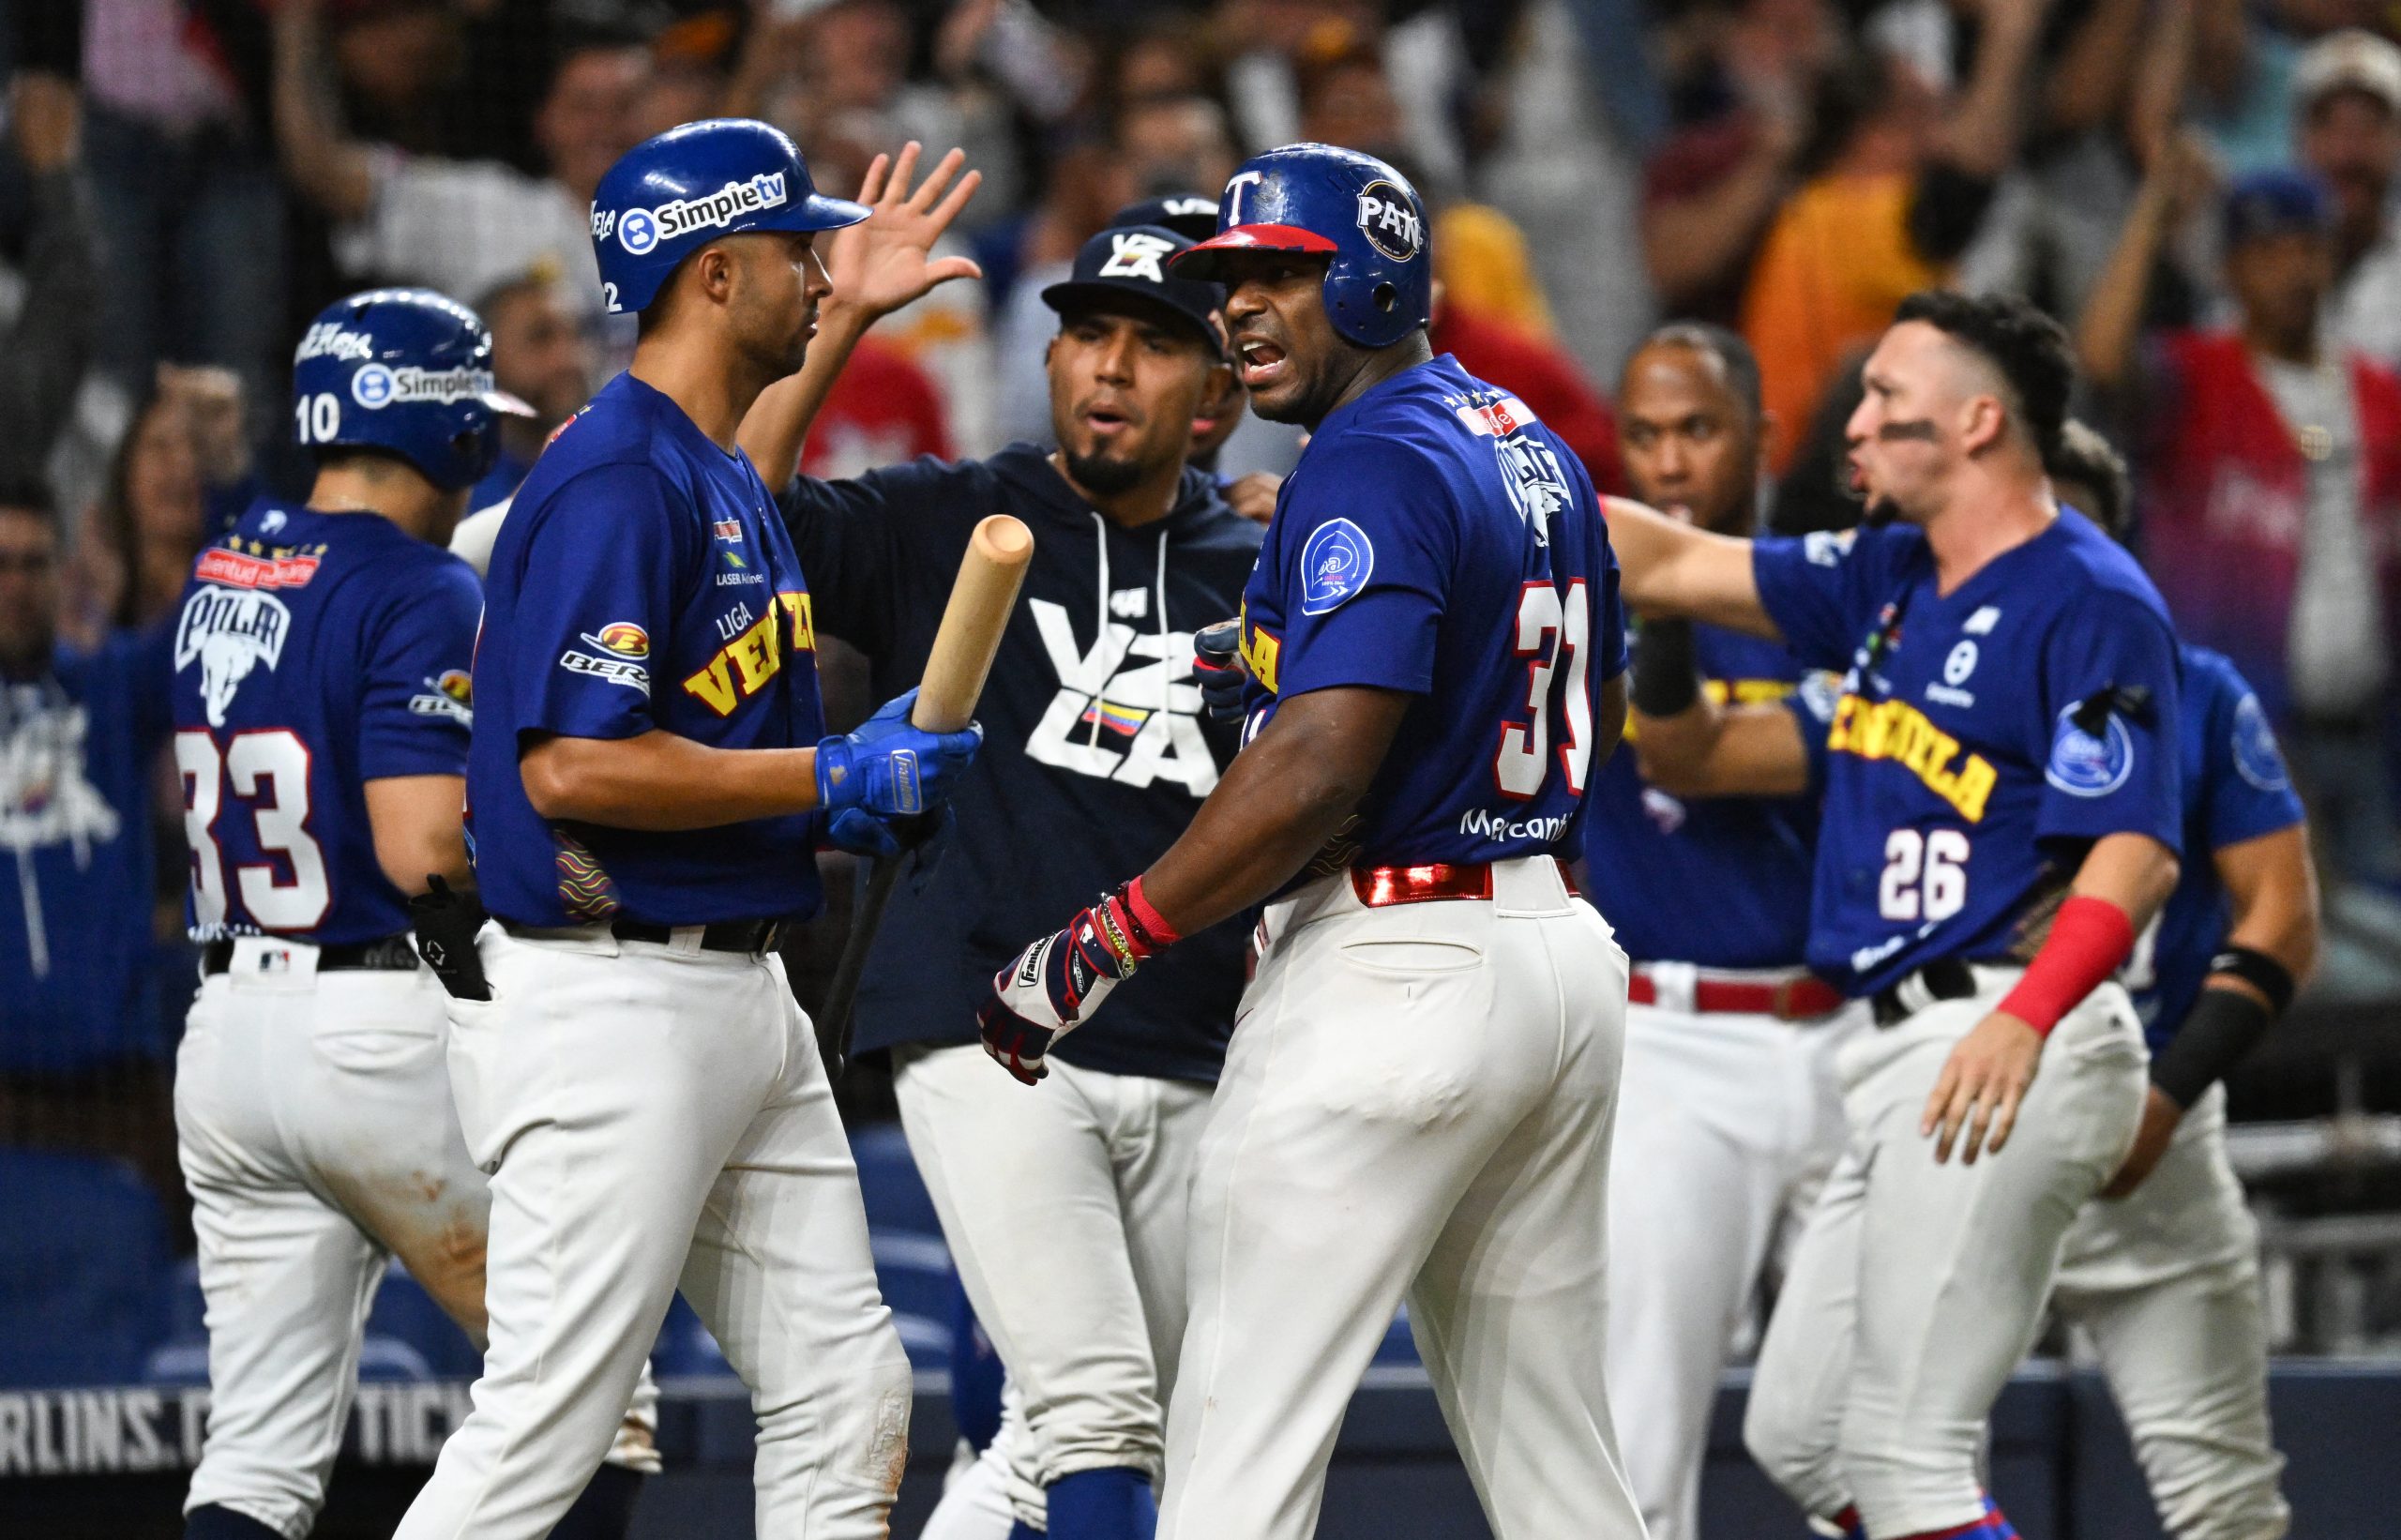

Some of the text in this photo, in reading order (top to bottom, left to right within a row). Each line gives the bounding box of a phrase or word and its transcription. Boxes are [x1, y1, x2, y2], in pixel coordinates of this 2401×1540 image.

[657, 176, 783, 234] Simpletv
[1225, 171, 1261, 227] T
[295, 392, 340, 445] 10
[716, 573, 742, 586] LASER
[716, 601, 753, 641] LIGA
[1493, 577, 1593, 802] 31
[174, 728, 331, 933] 33
[1880, 828, 1970, 922] 26
